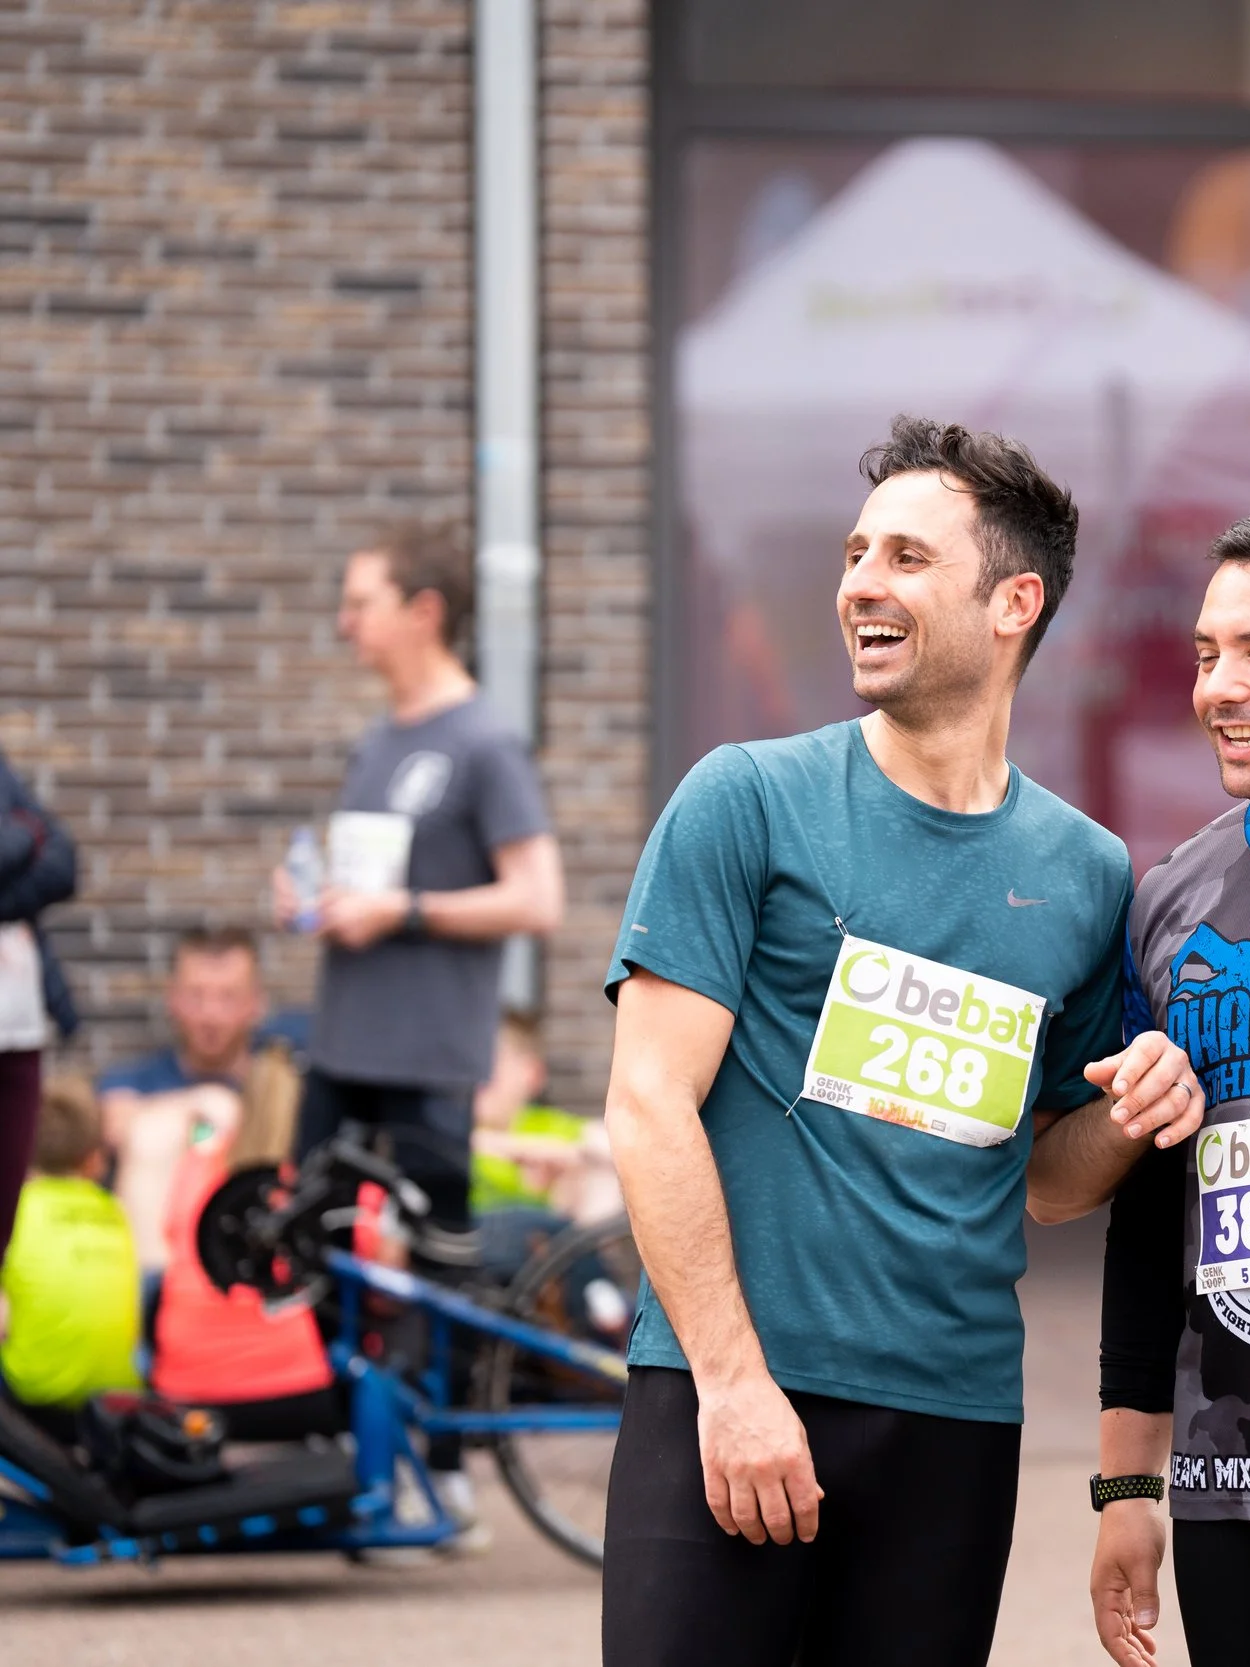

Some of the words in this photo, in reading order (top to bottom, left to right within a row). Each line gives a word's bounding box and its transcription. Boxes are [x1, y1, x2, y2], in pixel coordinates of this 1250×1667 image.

[895, 964, 1036, 1053] bebat
[860, 1024, 988, 1108] 268
[816, 1077, 853, 1095] GENK
[810, 1086, 853, 1106] LOOPT
[868, 1096, 886, 1114] 10
[1203, 1266, 1224, 1278] GENK
